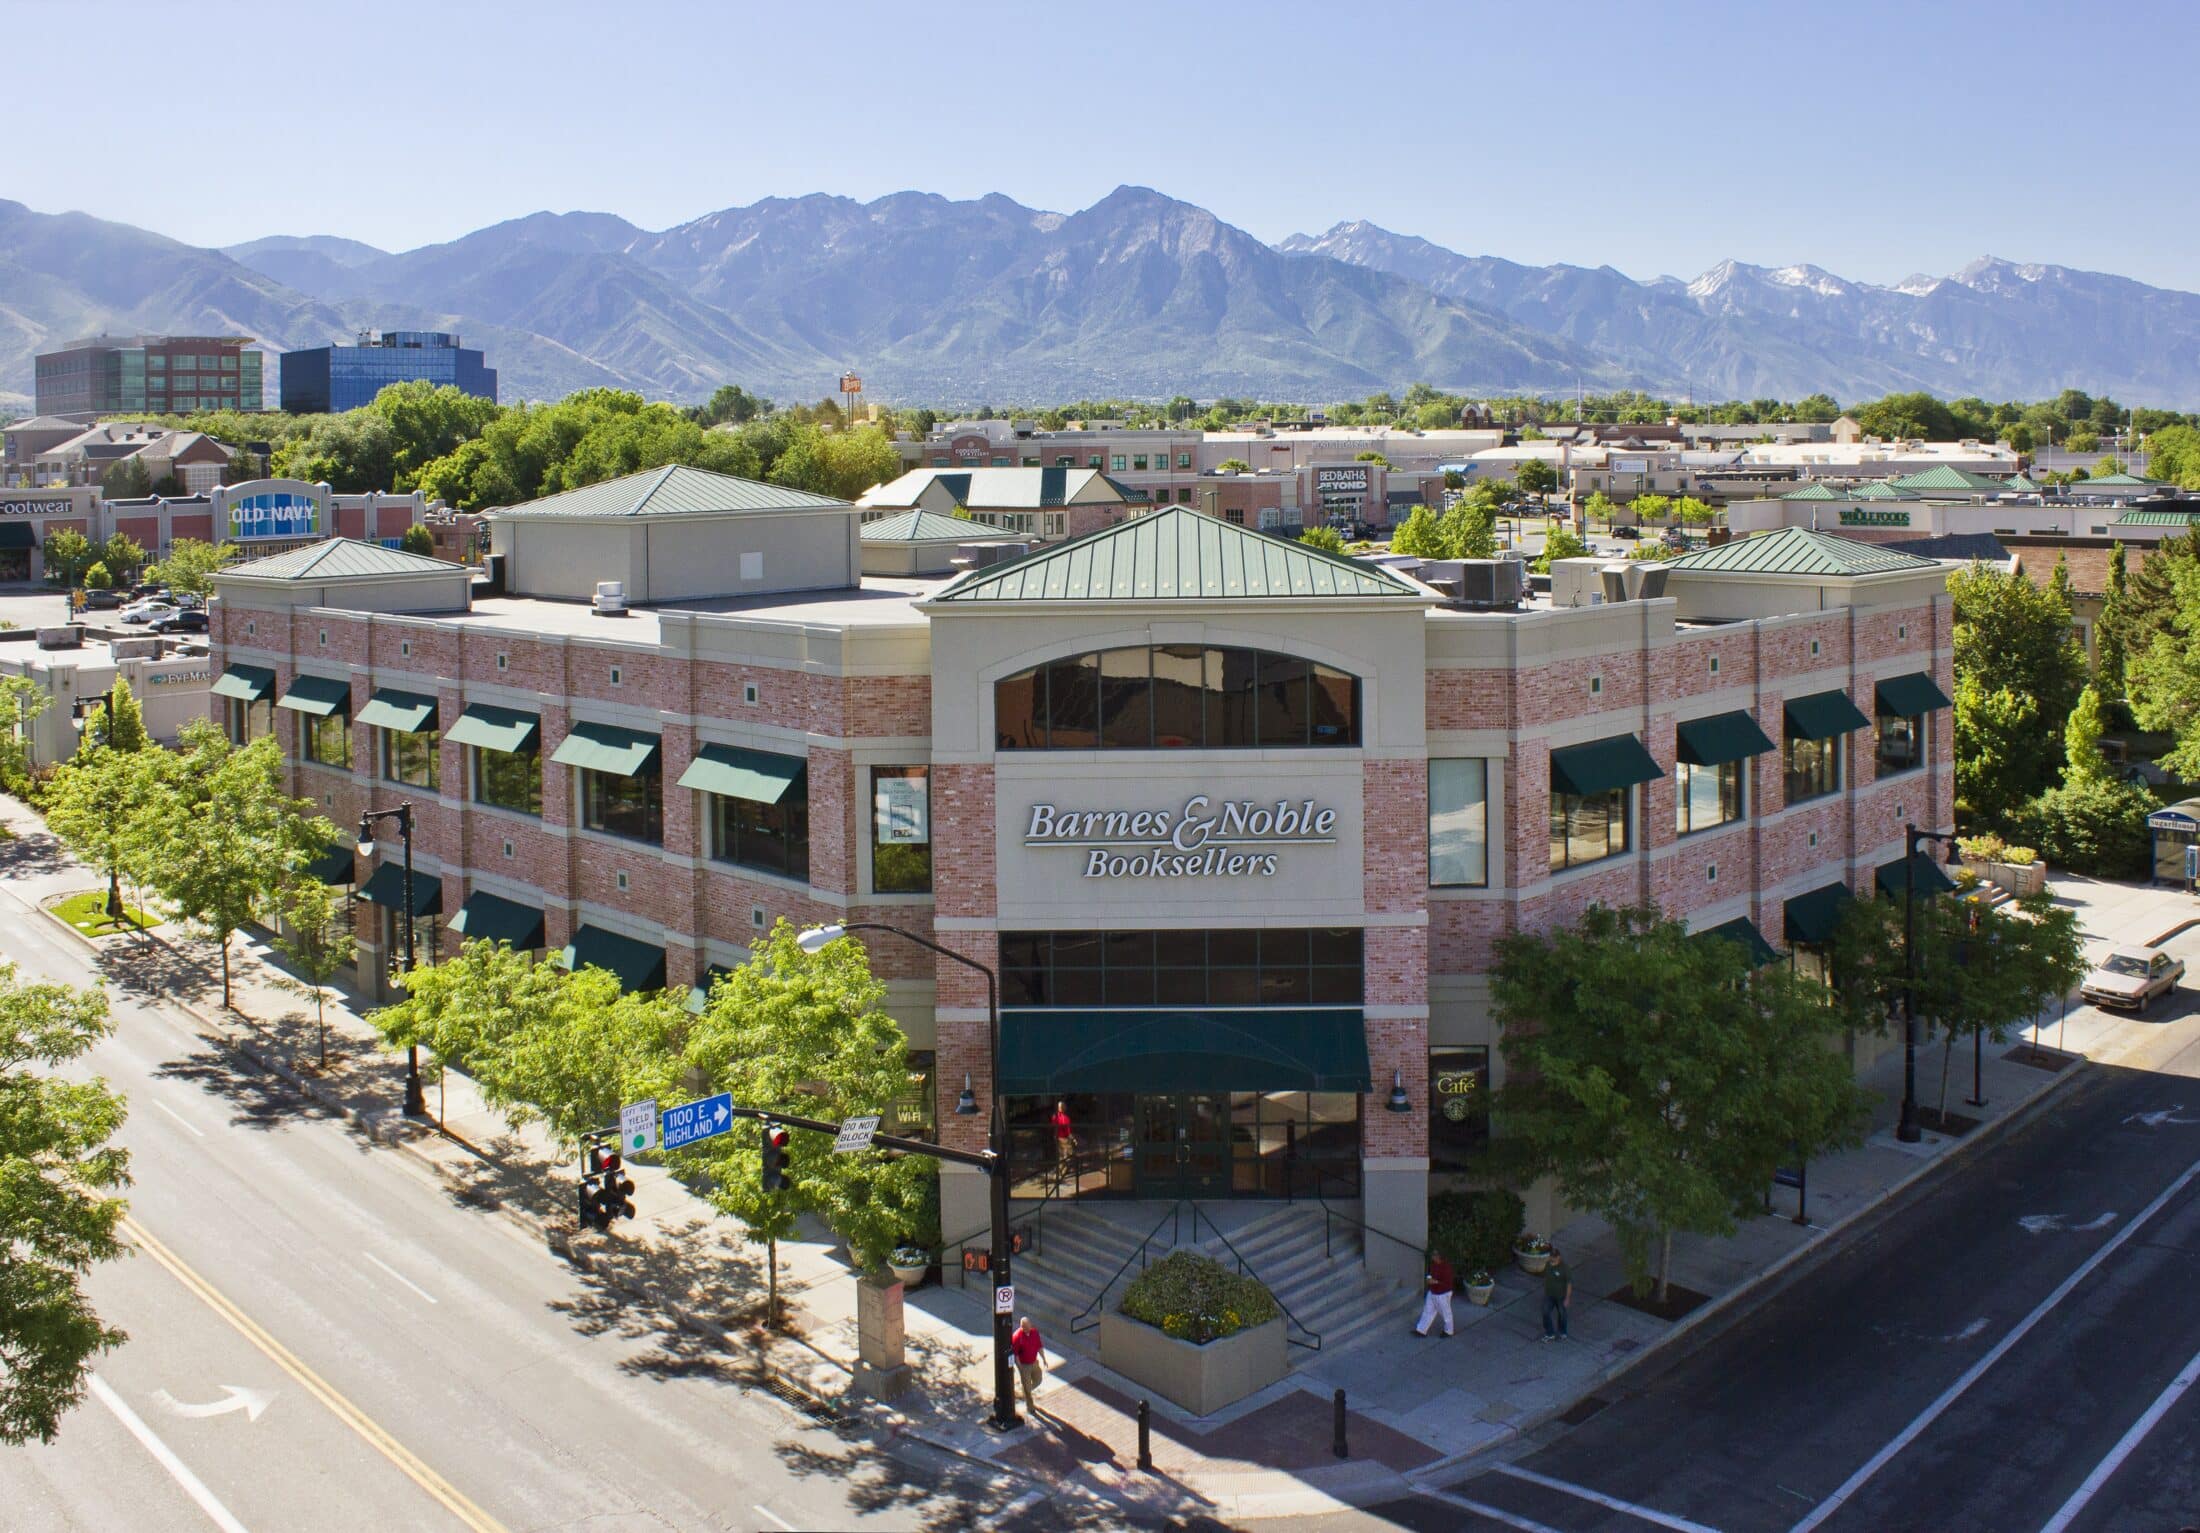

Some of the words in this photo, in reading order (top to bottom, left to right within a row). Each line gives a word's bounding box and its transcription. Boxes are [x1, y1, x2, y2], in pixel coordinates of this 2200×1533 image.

[1320, 470, 1336, 481] BED
[1337, 470, 1359, 480] BATH
[1320, 481, 1367, 490] BEYOND
[232, 508, 264, 523] OLD
[272, 505, 314, 521] NAVY
[1838, 508, 1876, 521] WHOLE
[1877, 511, 1910, 521] FOODS
[1025, 803, 1171, 838] Barnes
[1171, 795, 1217, 851] &
[1216, 800, 1336, 836] Noble
[1083, 848, 1278, 878] Booksellers
[1437, 1077, 1475, 1094] Café
[628, 1113, 649, 1125] YIELD
[669, 1108, 693, 1128] 1100
[844, 1122, 856, 1131] DO
[858, 1120, 875, 1129] NOT
[664, 1119, 713, 1147] HIGHLAND
[840, 1132, 870, 1142] BLOCK
